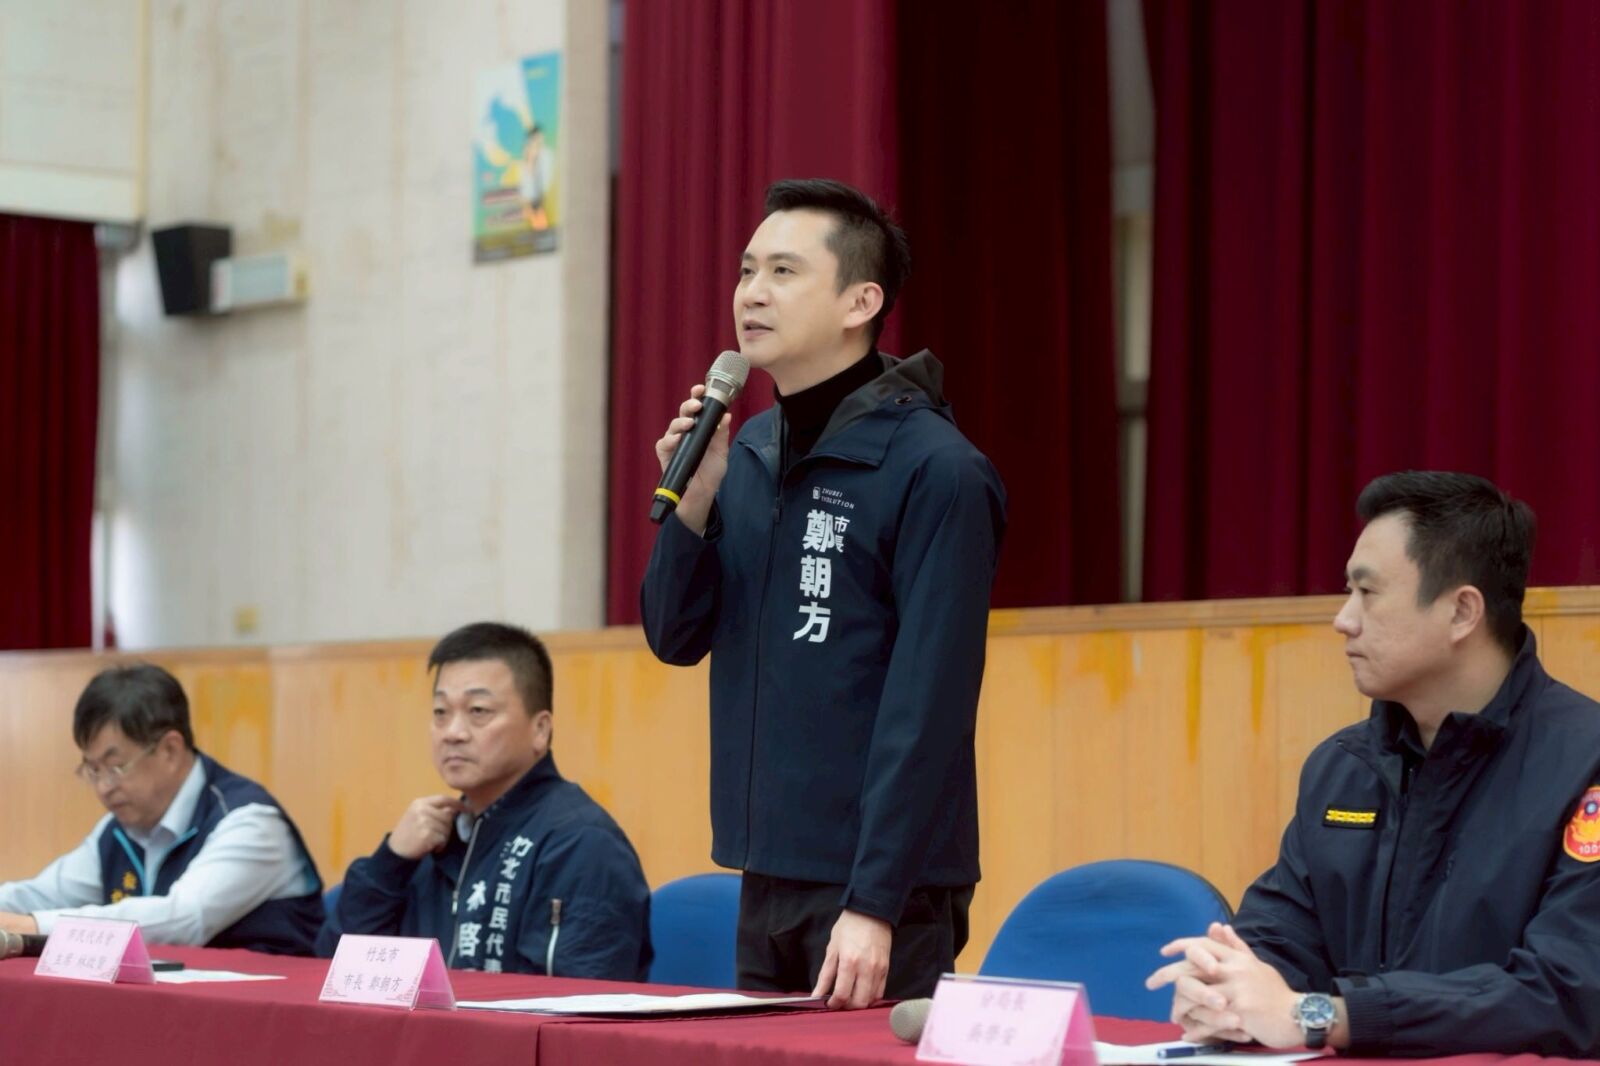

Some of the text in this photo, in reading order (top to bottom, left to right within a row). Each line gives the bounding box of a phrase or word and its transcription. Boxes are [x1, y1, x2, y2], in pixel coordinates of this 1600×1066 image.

[834, 516, 850, 553] 市長
[793, 509, 835, 643] 鄭朝方
[366, 946, 400, 962] 竹北市
